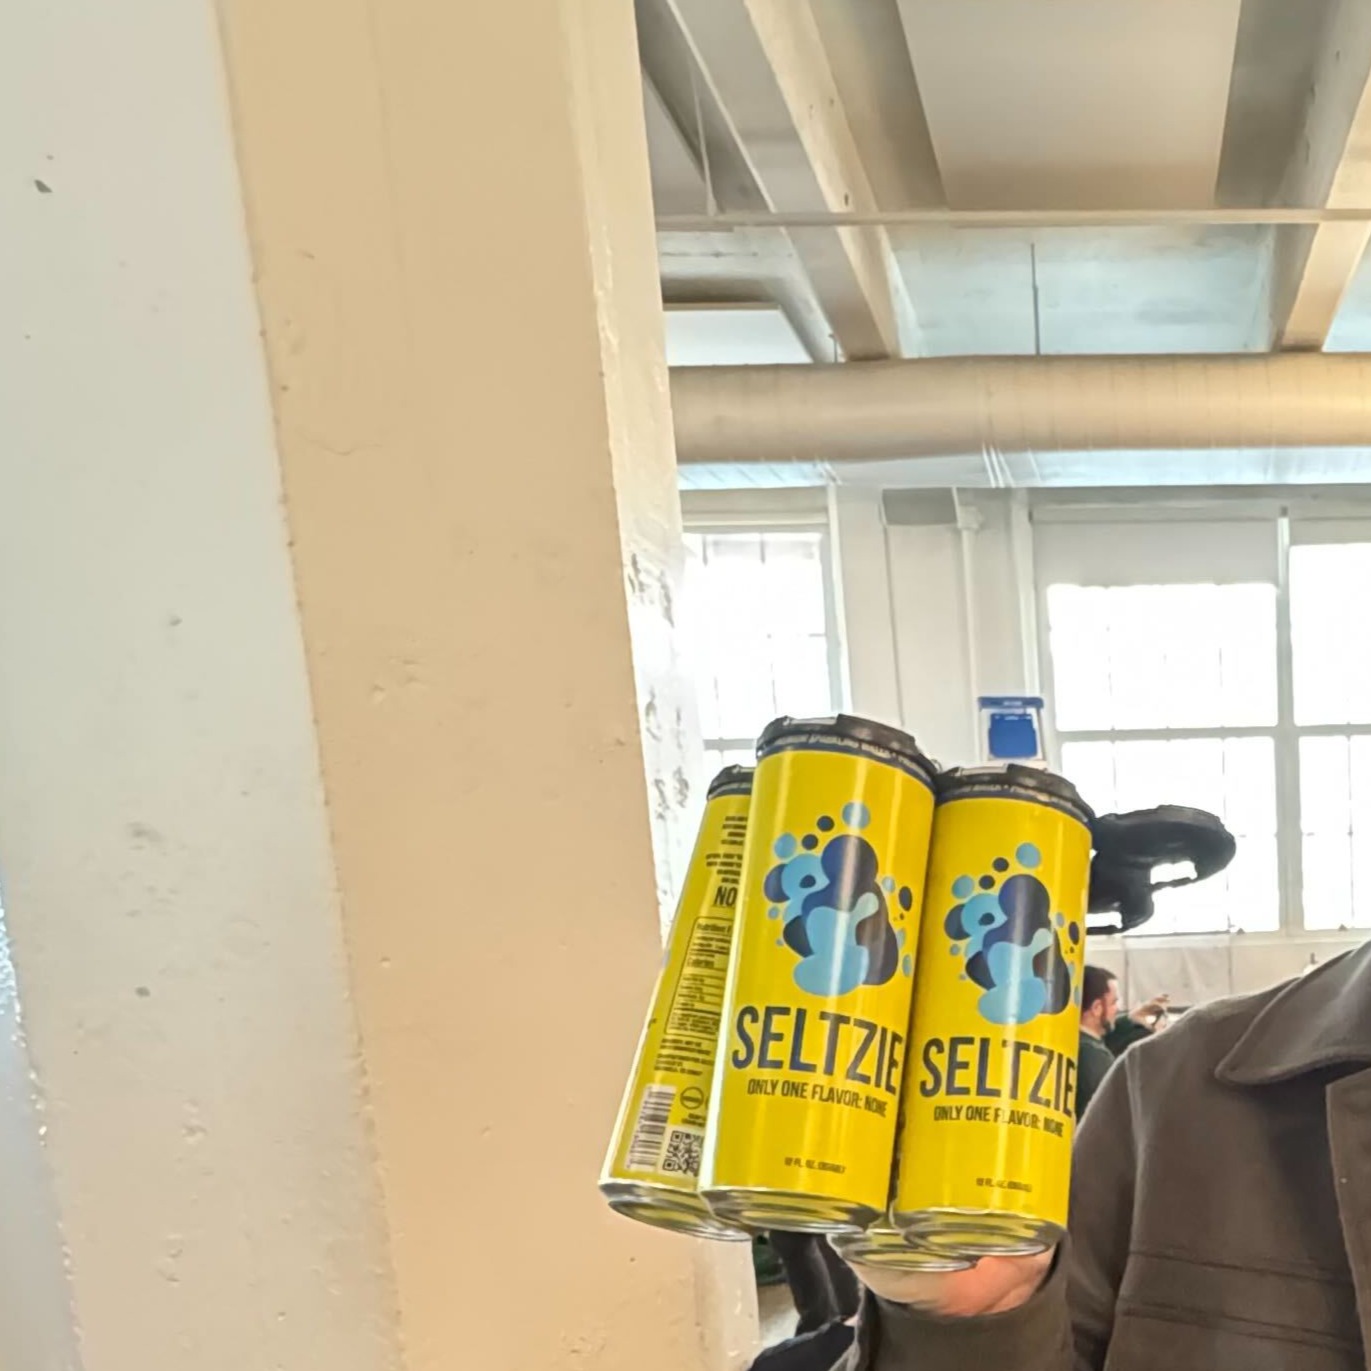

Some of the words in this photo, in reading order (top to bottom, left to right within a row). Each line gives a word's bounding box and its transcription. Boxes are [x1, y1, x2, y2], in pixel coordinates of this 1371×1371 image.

[731, 1005, 903, 1097] SELTZIE
[919, 1036, 1076, 1118] SELTZIE
[747, 1078, 780, 1096] ONLY
[781, 1079, 808, 1099] ONE
[811, 1084, 863, 1109] FLAVOR:
[933, 1105, 964, 1122] ONLY
[965, 1105, 992, 1122] ONE
[993, 1107, 1041, 1130] FLAVOR:
